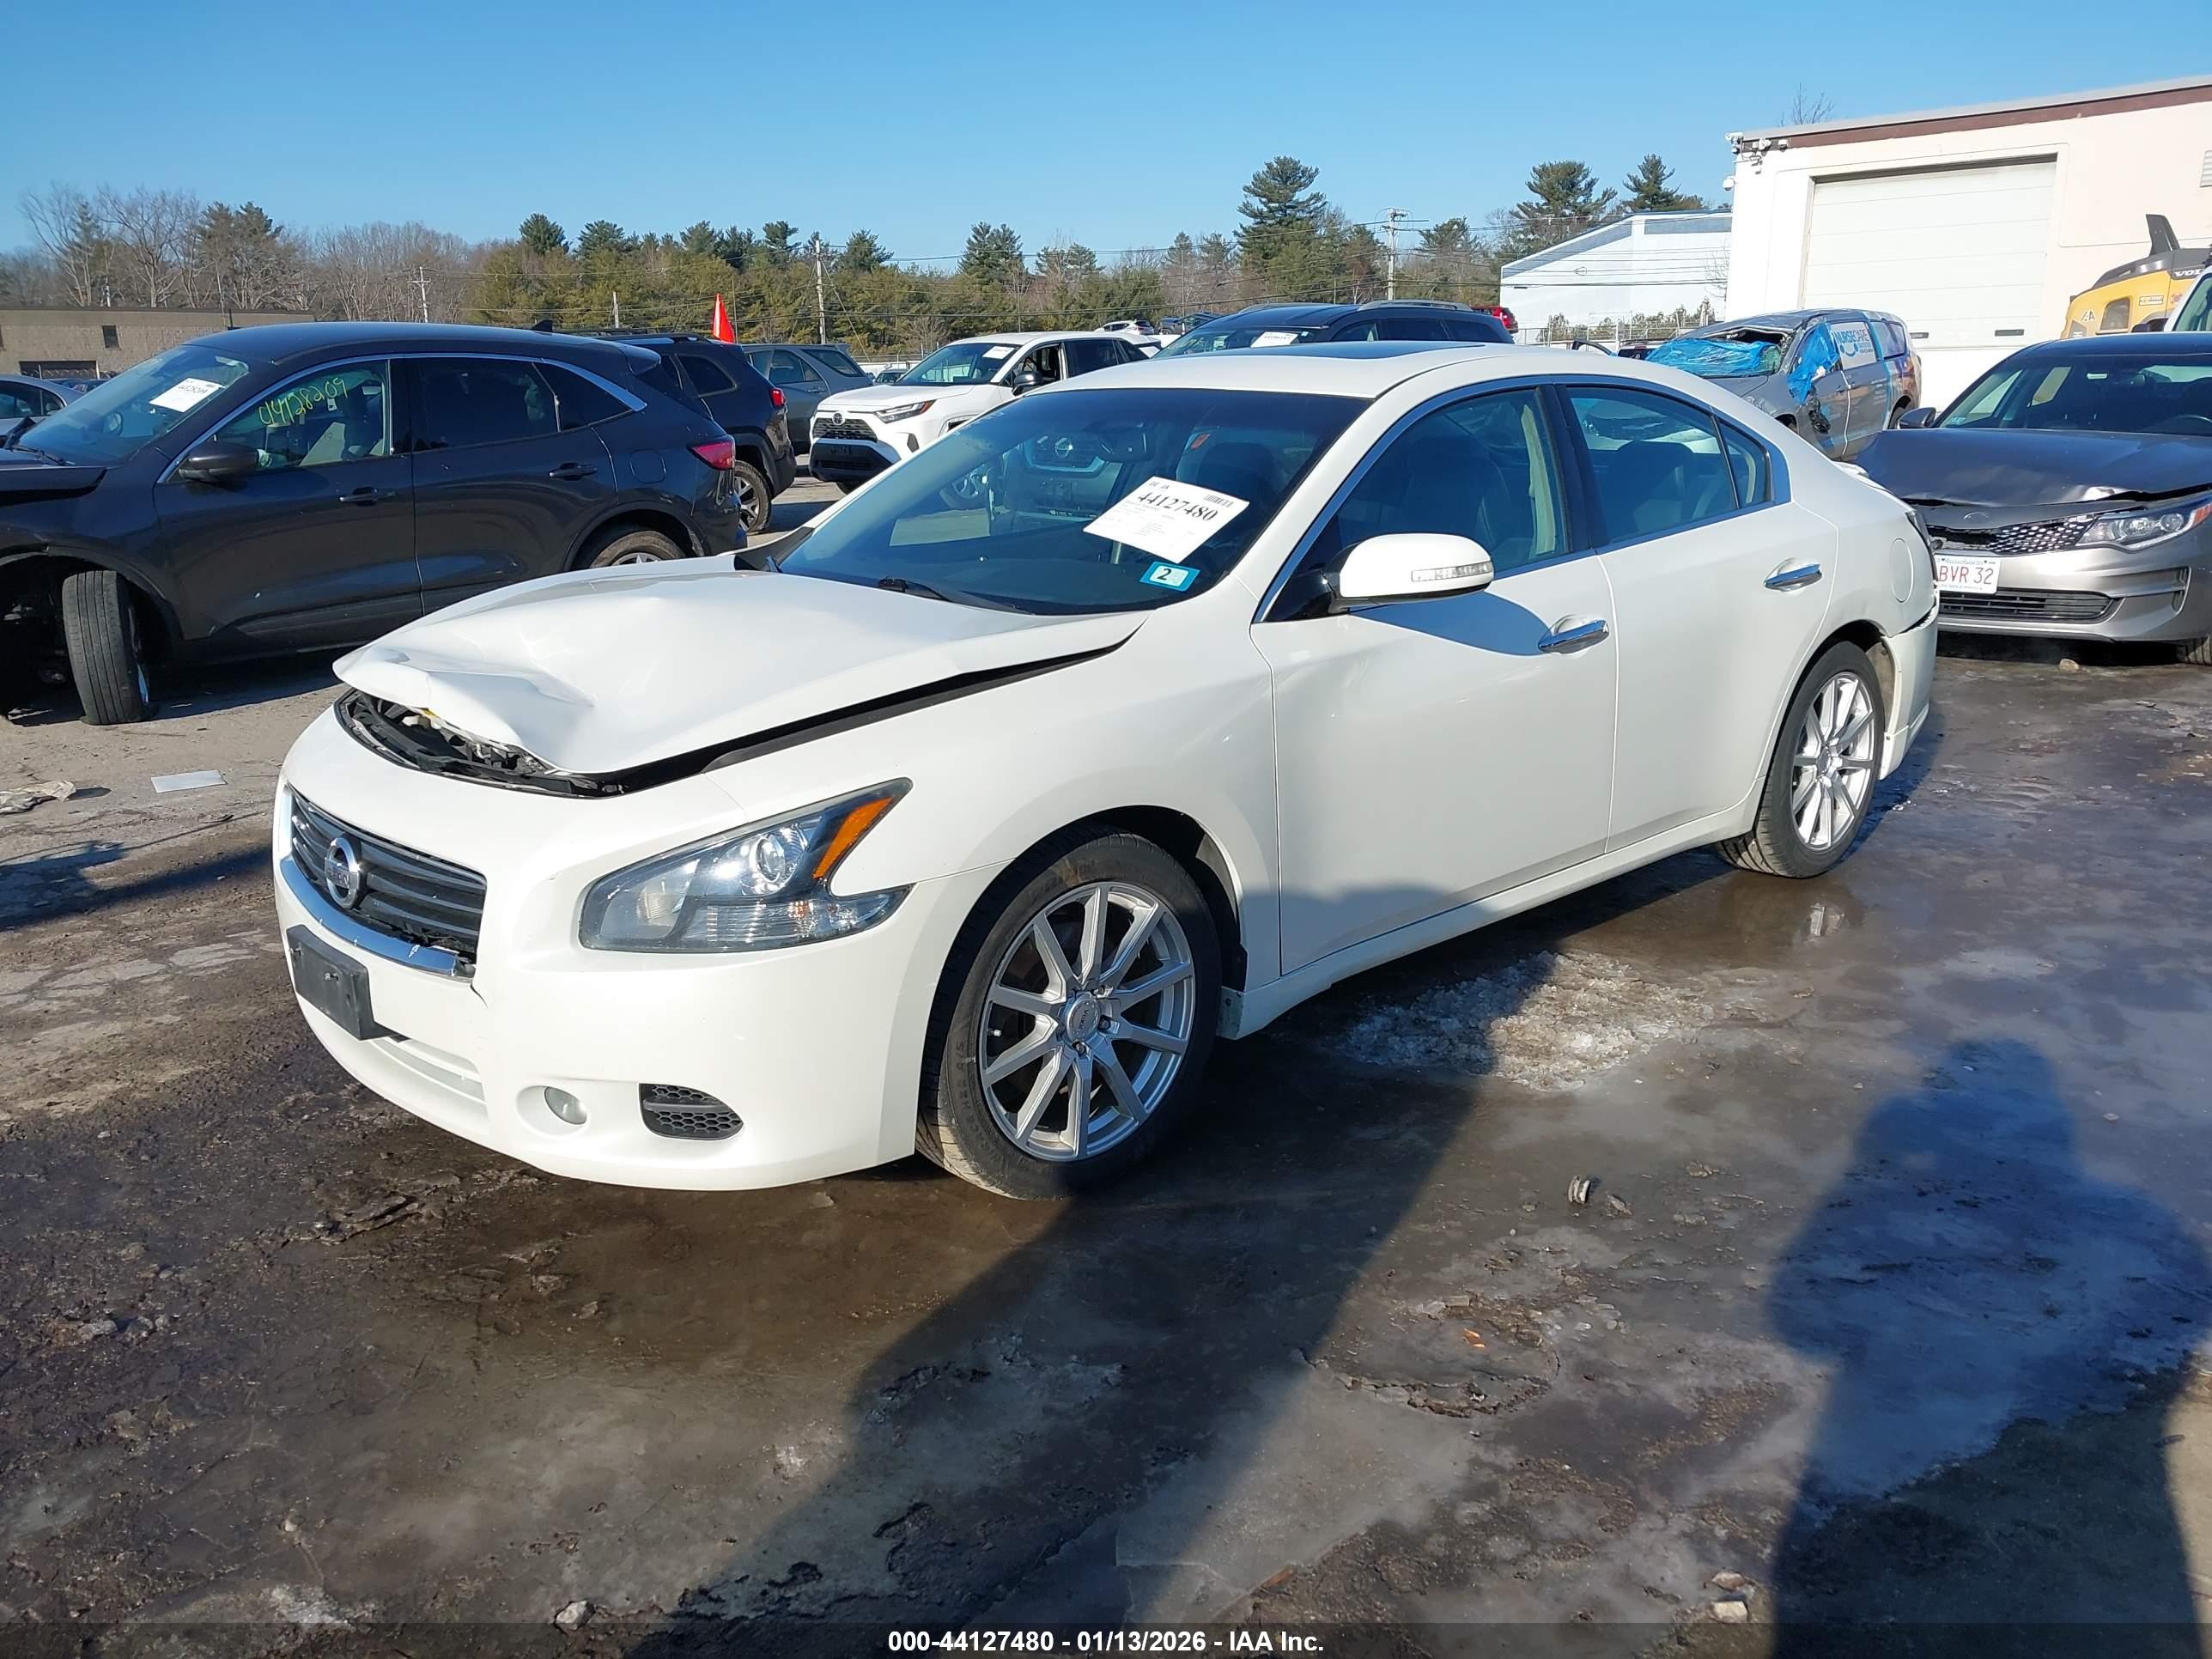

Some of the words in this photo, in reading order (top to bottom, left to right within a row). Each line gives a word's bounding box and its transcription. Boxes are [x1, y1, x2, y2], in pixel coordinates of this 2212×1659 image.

[1138, 491, 1218, 521] 44127480
[1157, 568, 1172, 580] 2
[1938, 565, 1969, 584] BVR
[1973, 567, 1994, 585] 32
